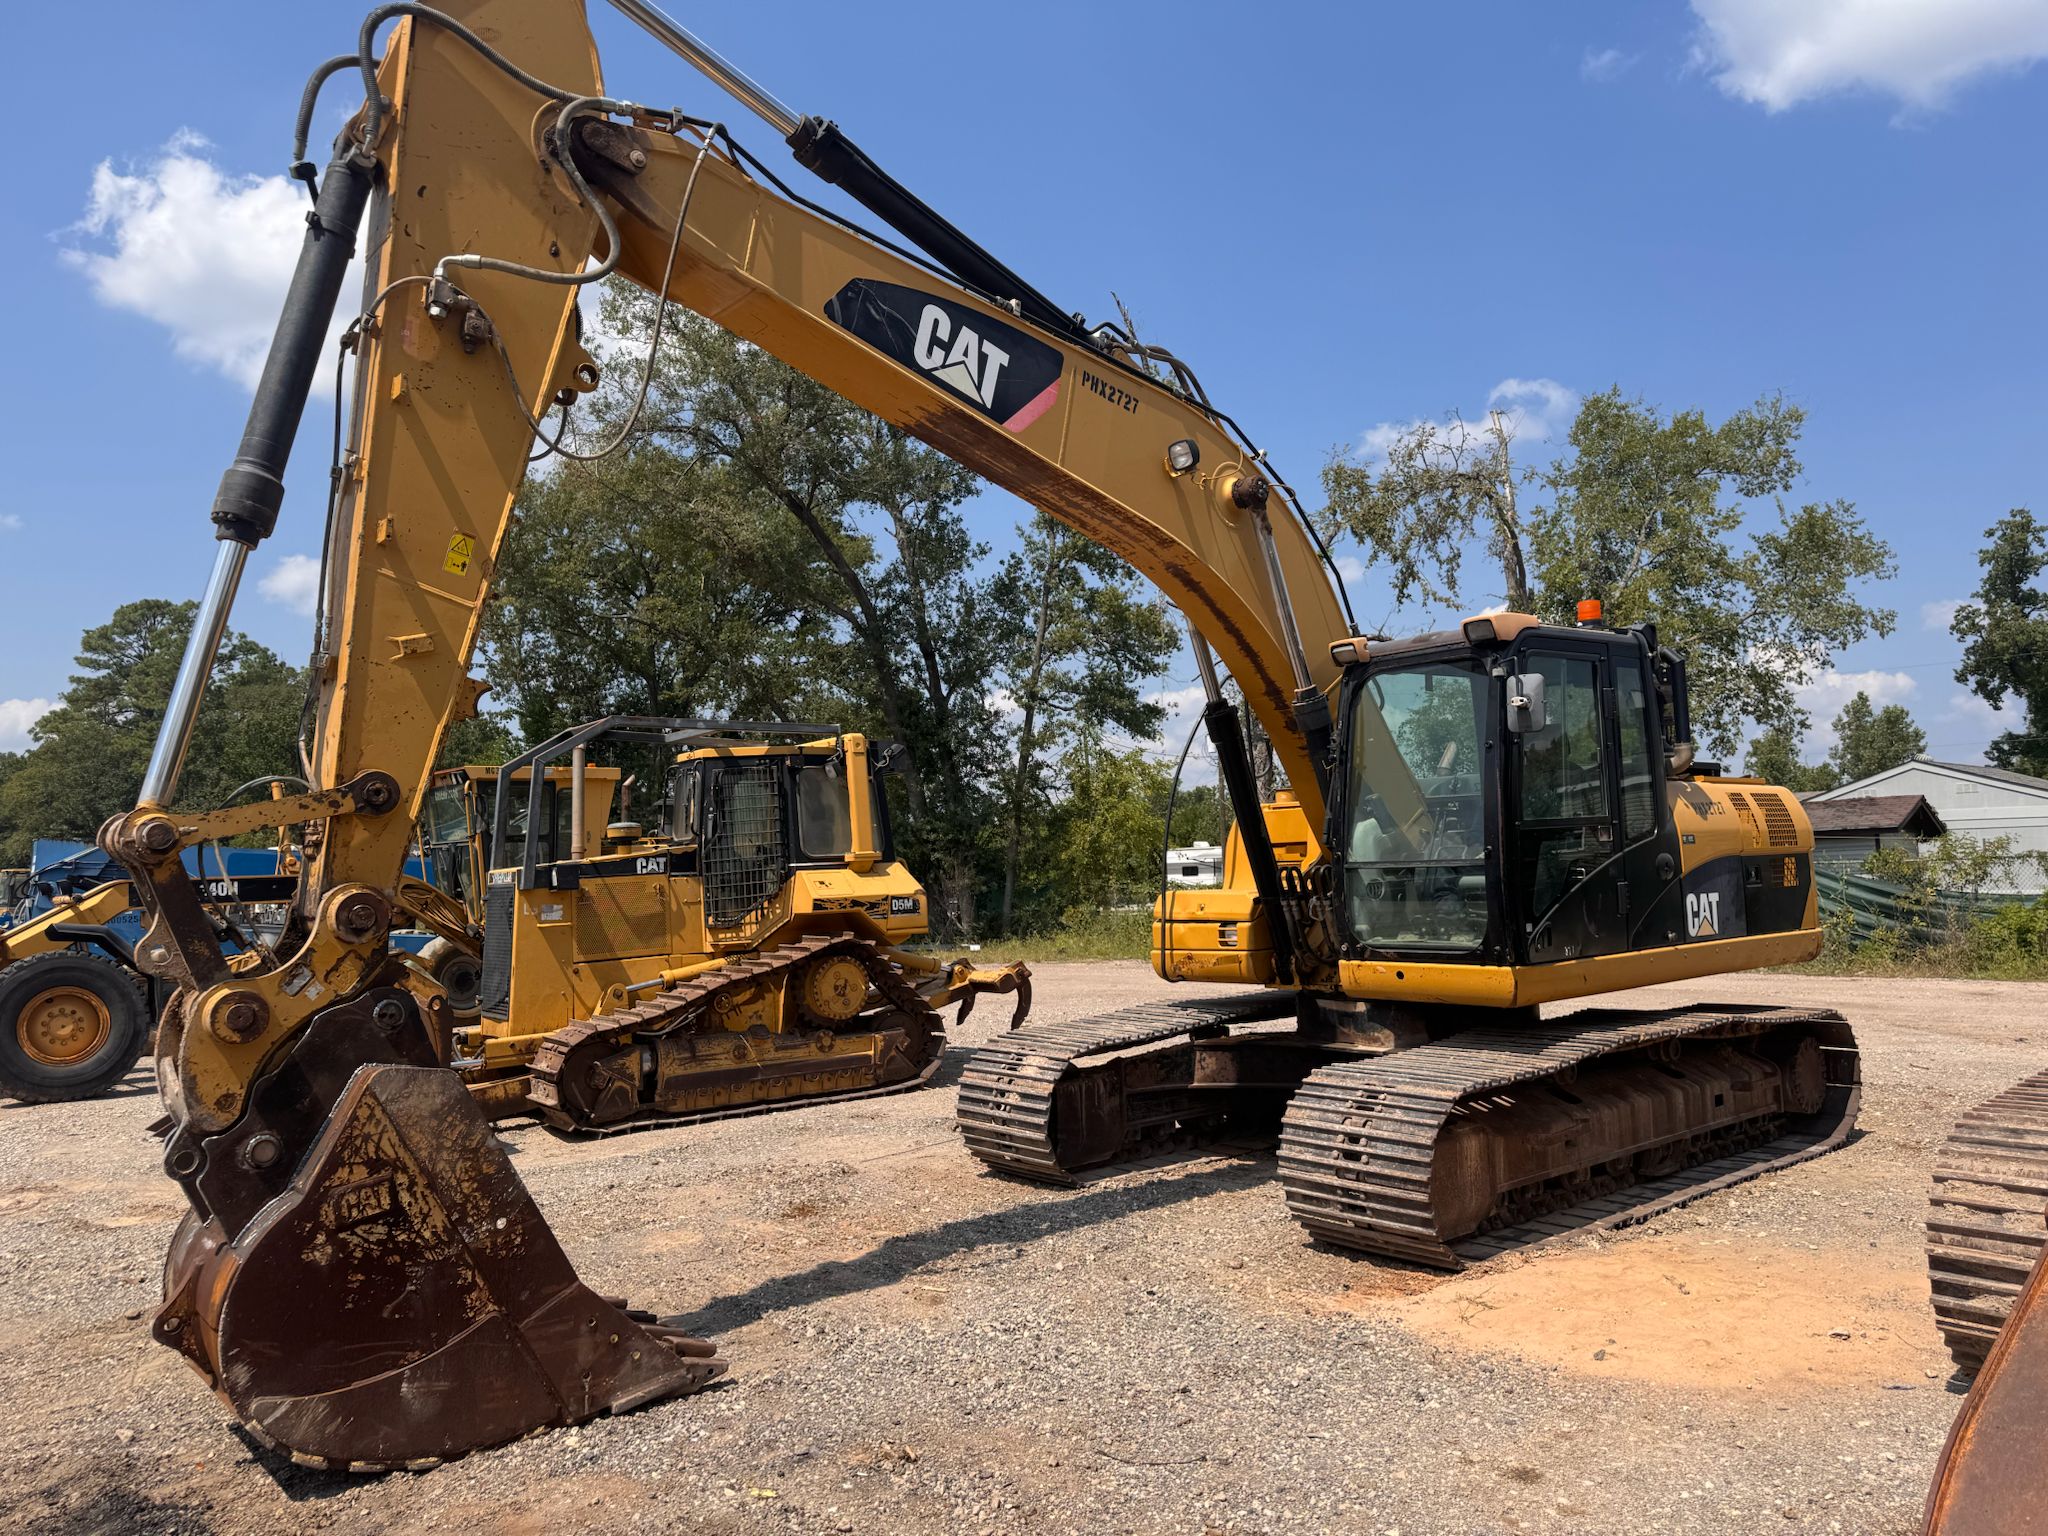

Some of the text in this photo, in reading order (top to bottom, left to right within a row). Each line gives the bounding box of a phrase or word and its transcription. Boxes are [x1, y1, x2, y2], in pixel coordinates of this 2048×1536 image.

[914, 304, 1010, 409] CAT
[1081, 370, 1139, 414] PHX2727
[636, 857, 667, 874] CAT
[892, 899, 913, 910] D5M
[1686, 892, 1719, 937] CAT
